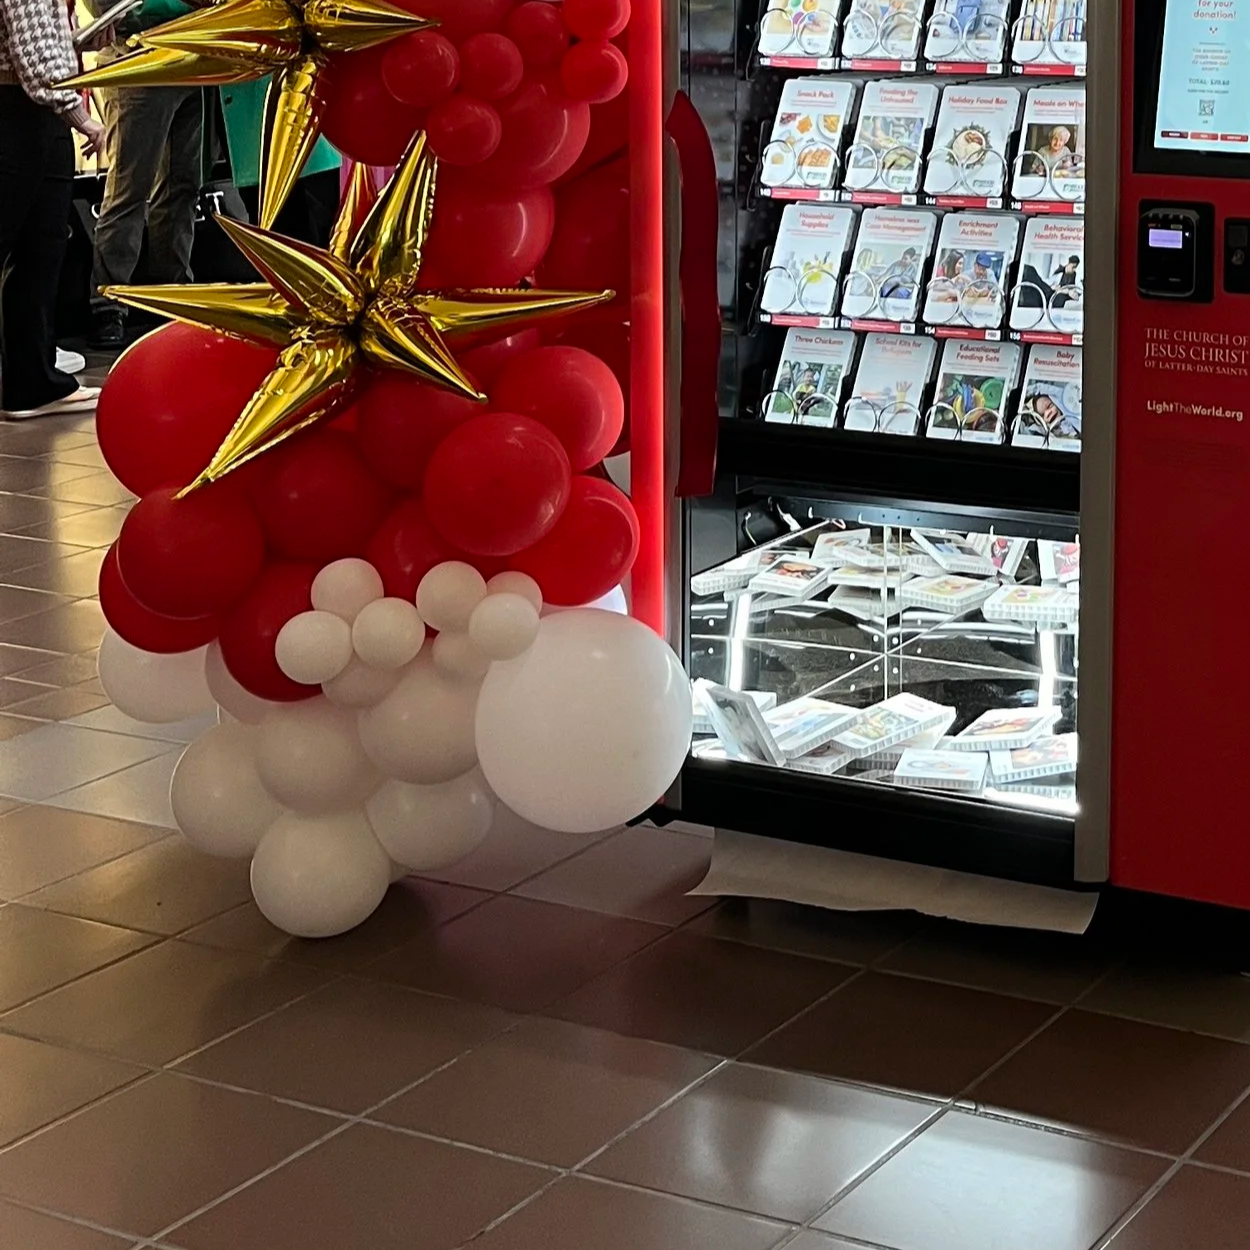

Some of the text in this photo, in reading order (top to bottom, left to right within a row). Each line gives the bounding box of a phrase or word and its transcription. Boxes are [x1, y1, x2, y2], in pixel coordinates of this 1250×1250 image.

[1198, 0, 1234, 10] for your
[1193, 10, 1237, 20] donation!
[958, 219, 999, 229] Enrichment
[1033, 232, 1058, 240] Health
[1144, 327, 1249, 347] THE CHURCH OF
[1056, 350, 1075, 361] Baby
[1144, 342, 1250, 364] JESUS CHRIST
[1144, 360, 1249, 377] OF LATTER-DAY SAINTS
[1147, 400, 1244, 422] LightTheWorld.org
